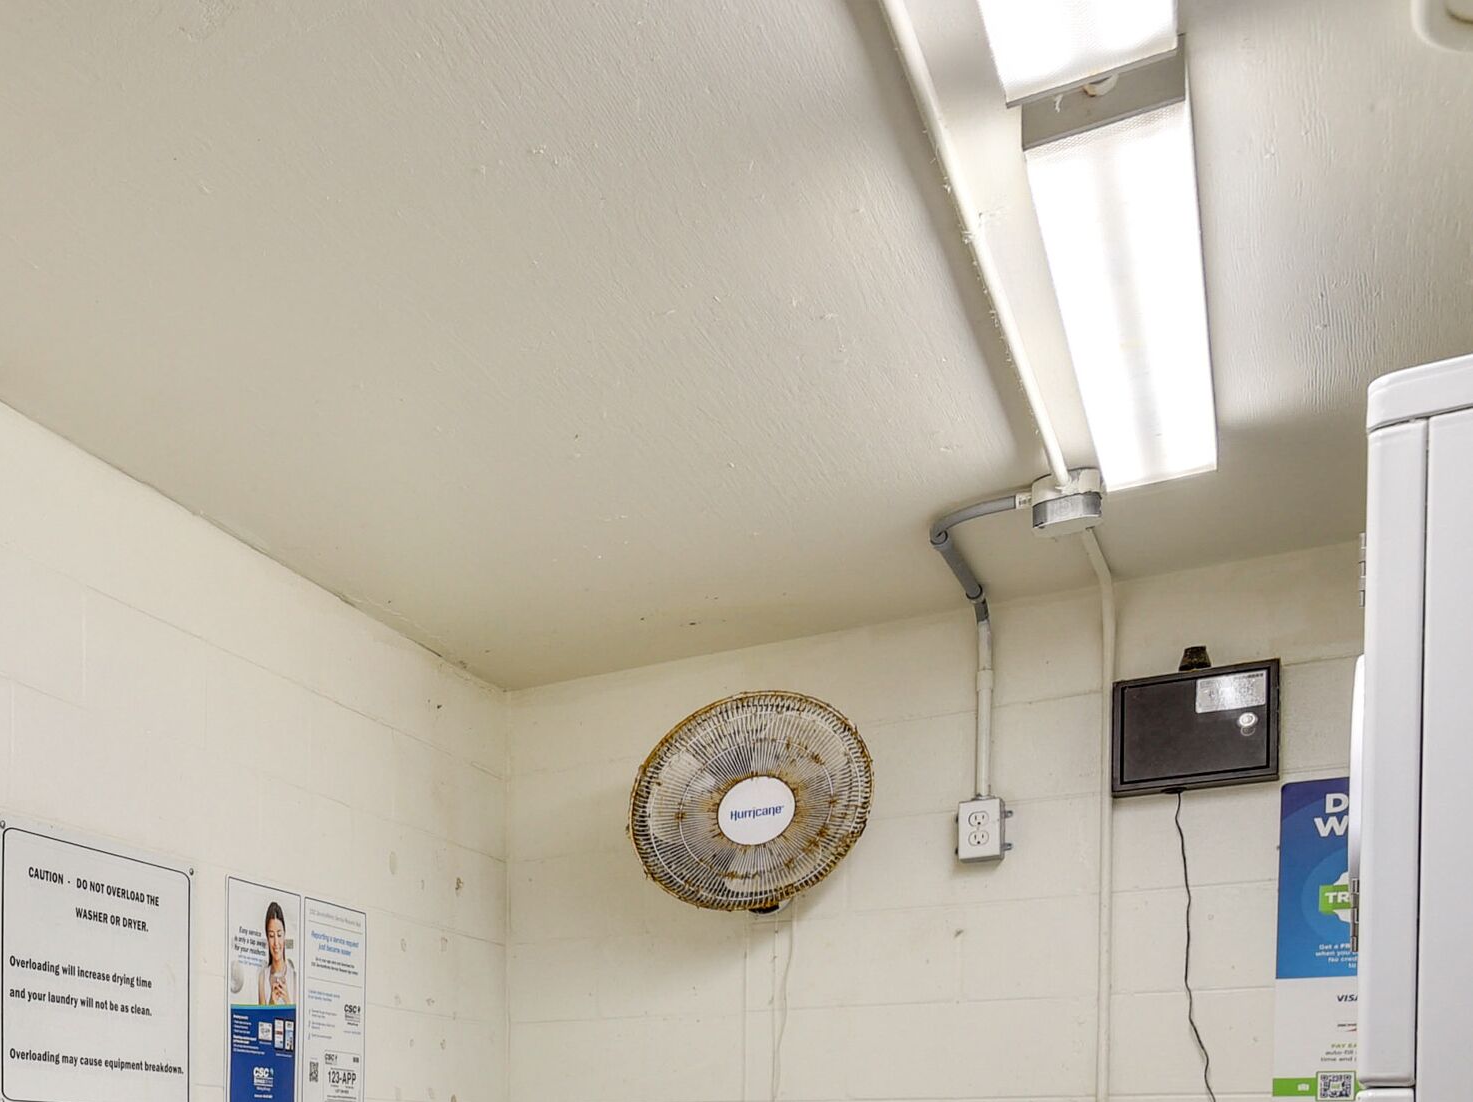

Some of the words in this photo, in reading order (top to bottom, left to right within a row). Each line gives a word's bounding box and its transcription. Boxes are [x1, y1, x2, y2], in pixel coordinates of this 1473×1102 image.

[730, 805, 783, 821] Hurricane
[28, 866, 64, 885] CAUTION
[76, 877, 88, 891] DO
[89, 880, 105, 894] NOT
[106, 884, 145, 903] OVERLOAD
[146, 894, 160, 907] THE
[75, 907, 109, 924] WASHER
[109, 914, 121, 927] OR
[122, 916, 149, 932] DRYER.
[9, 955, 60, 977] Overloading
[61, 964, 76, 977] will
[77, 965, 111, 982] increase
[111, 972, 135, 988] drying
[135, 976, 152, 989] time
[9, 988, 26, 999] and
[27, 991, 47, 1003] your
[47, 991, 79, 1009] laundry
[79, 996, 94, 1008] will
[95, 999, 108, 1010] not
[109, 1000, 119, 1012] be
[120, 1004, 129, 1014] as
[130, 1004, 152, 1017] clean.
[344, 1004, 357, 1014] CSC
[9, 1047, 61, 1066] Overloading
[61, 1055, 78, 1067] may
[79, 1056, 103, 1067] cause
[104, 1058, 143, 1071] equipment
[144, 1060, 184, 1075] breakdown.
[253, 1067, 269, 1077] CSC
[328, 1071, 357, 1090] 123-APP
